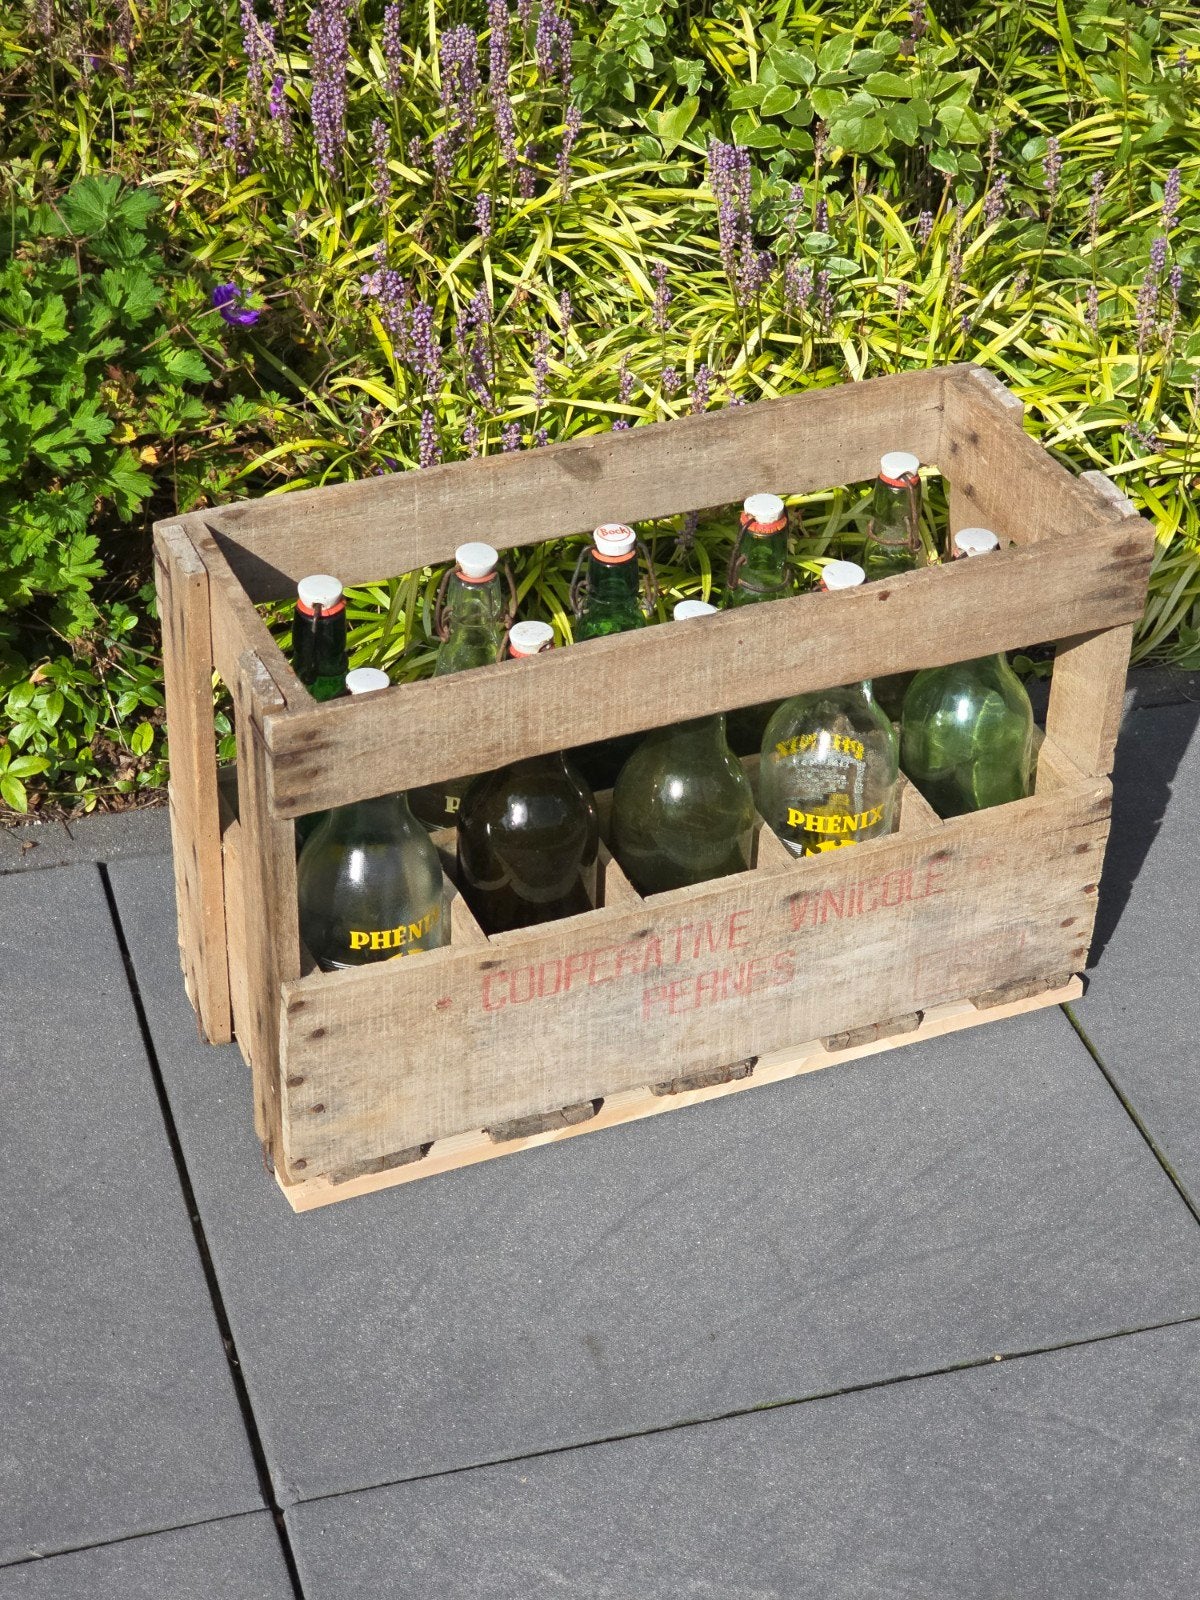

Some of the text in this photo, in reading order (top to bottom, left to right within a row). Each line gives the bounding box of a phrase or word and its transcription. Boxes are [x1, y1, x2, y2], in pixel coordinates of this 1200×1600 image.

[600, 526, 628, 537] Bock
[786, 803, 885, 834] PHÉNIX
[481, 855, 949, 1012] COOPERATIVE VINICOLE
[641, 950, 797, 1021] PERNES
